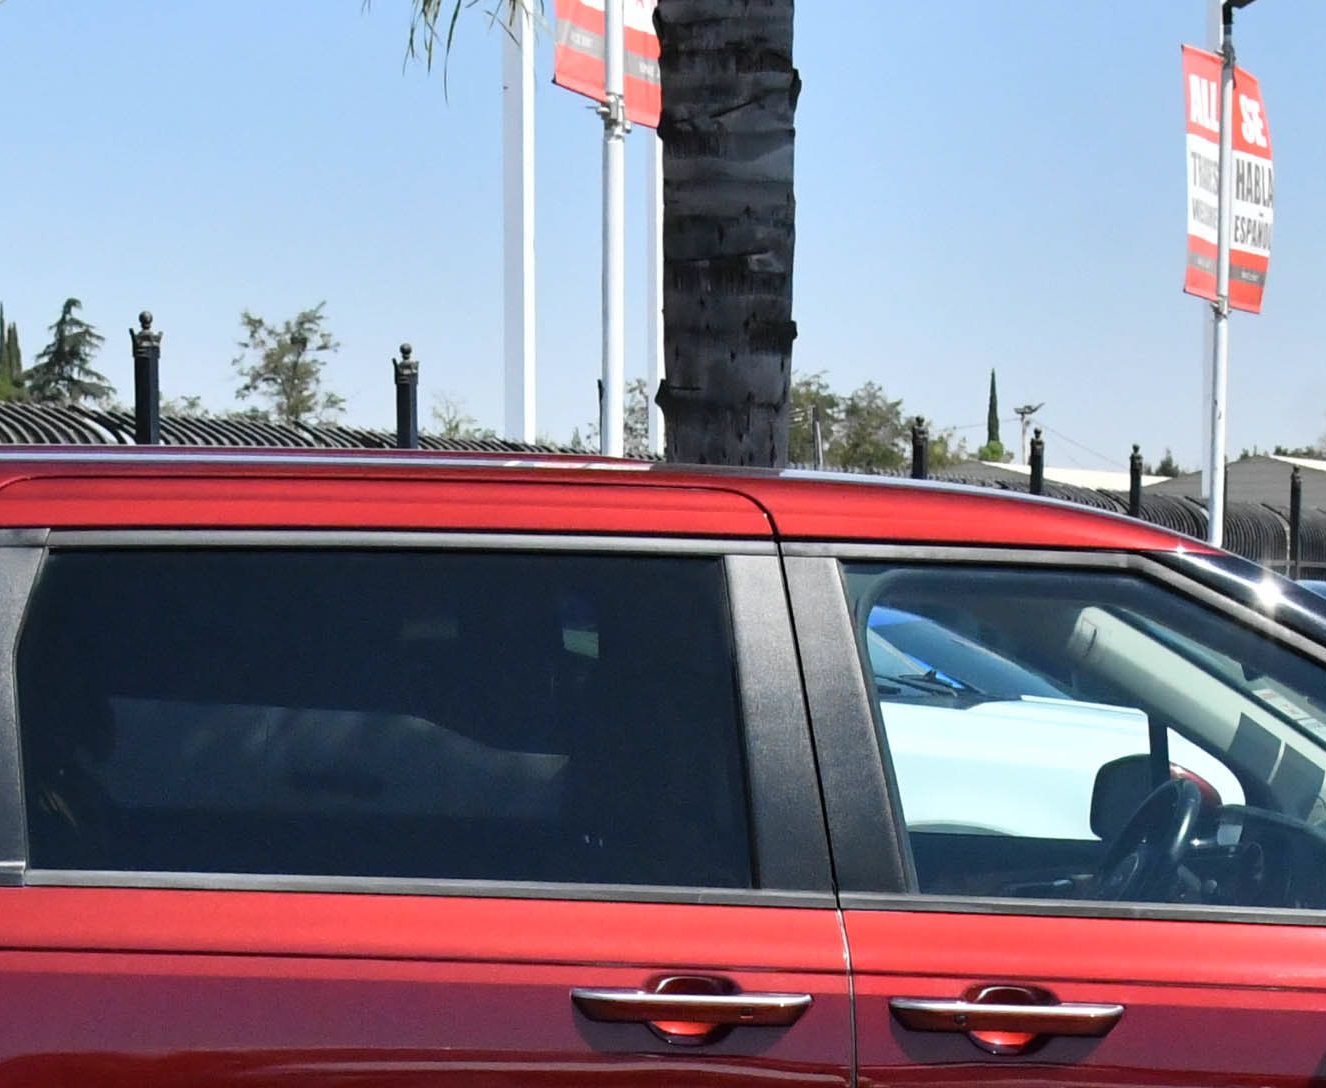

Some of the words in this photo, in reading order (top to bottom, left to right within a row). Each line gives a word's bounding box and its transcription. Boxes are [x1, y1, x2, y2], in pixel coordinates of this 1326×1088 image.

[1189, 74, 1220, 134] ALL
[1239, 94, 1267, 148] SE
[1235, 158, 1274, 208] HABLA
